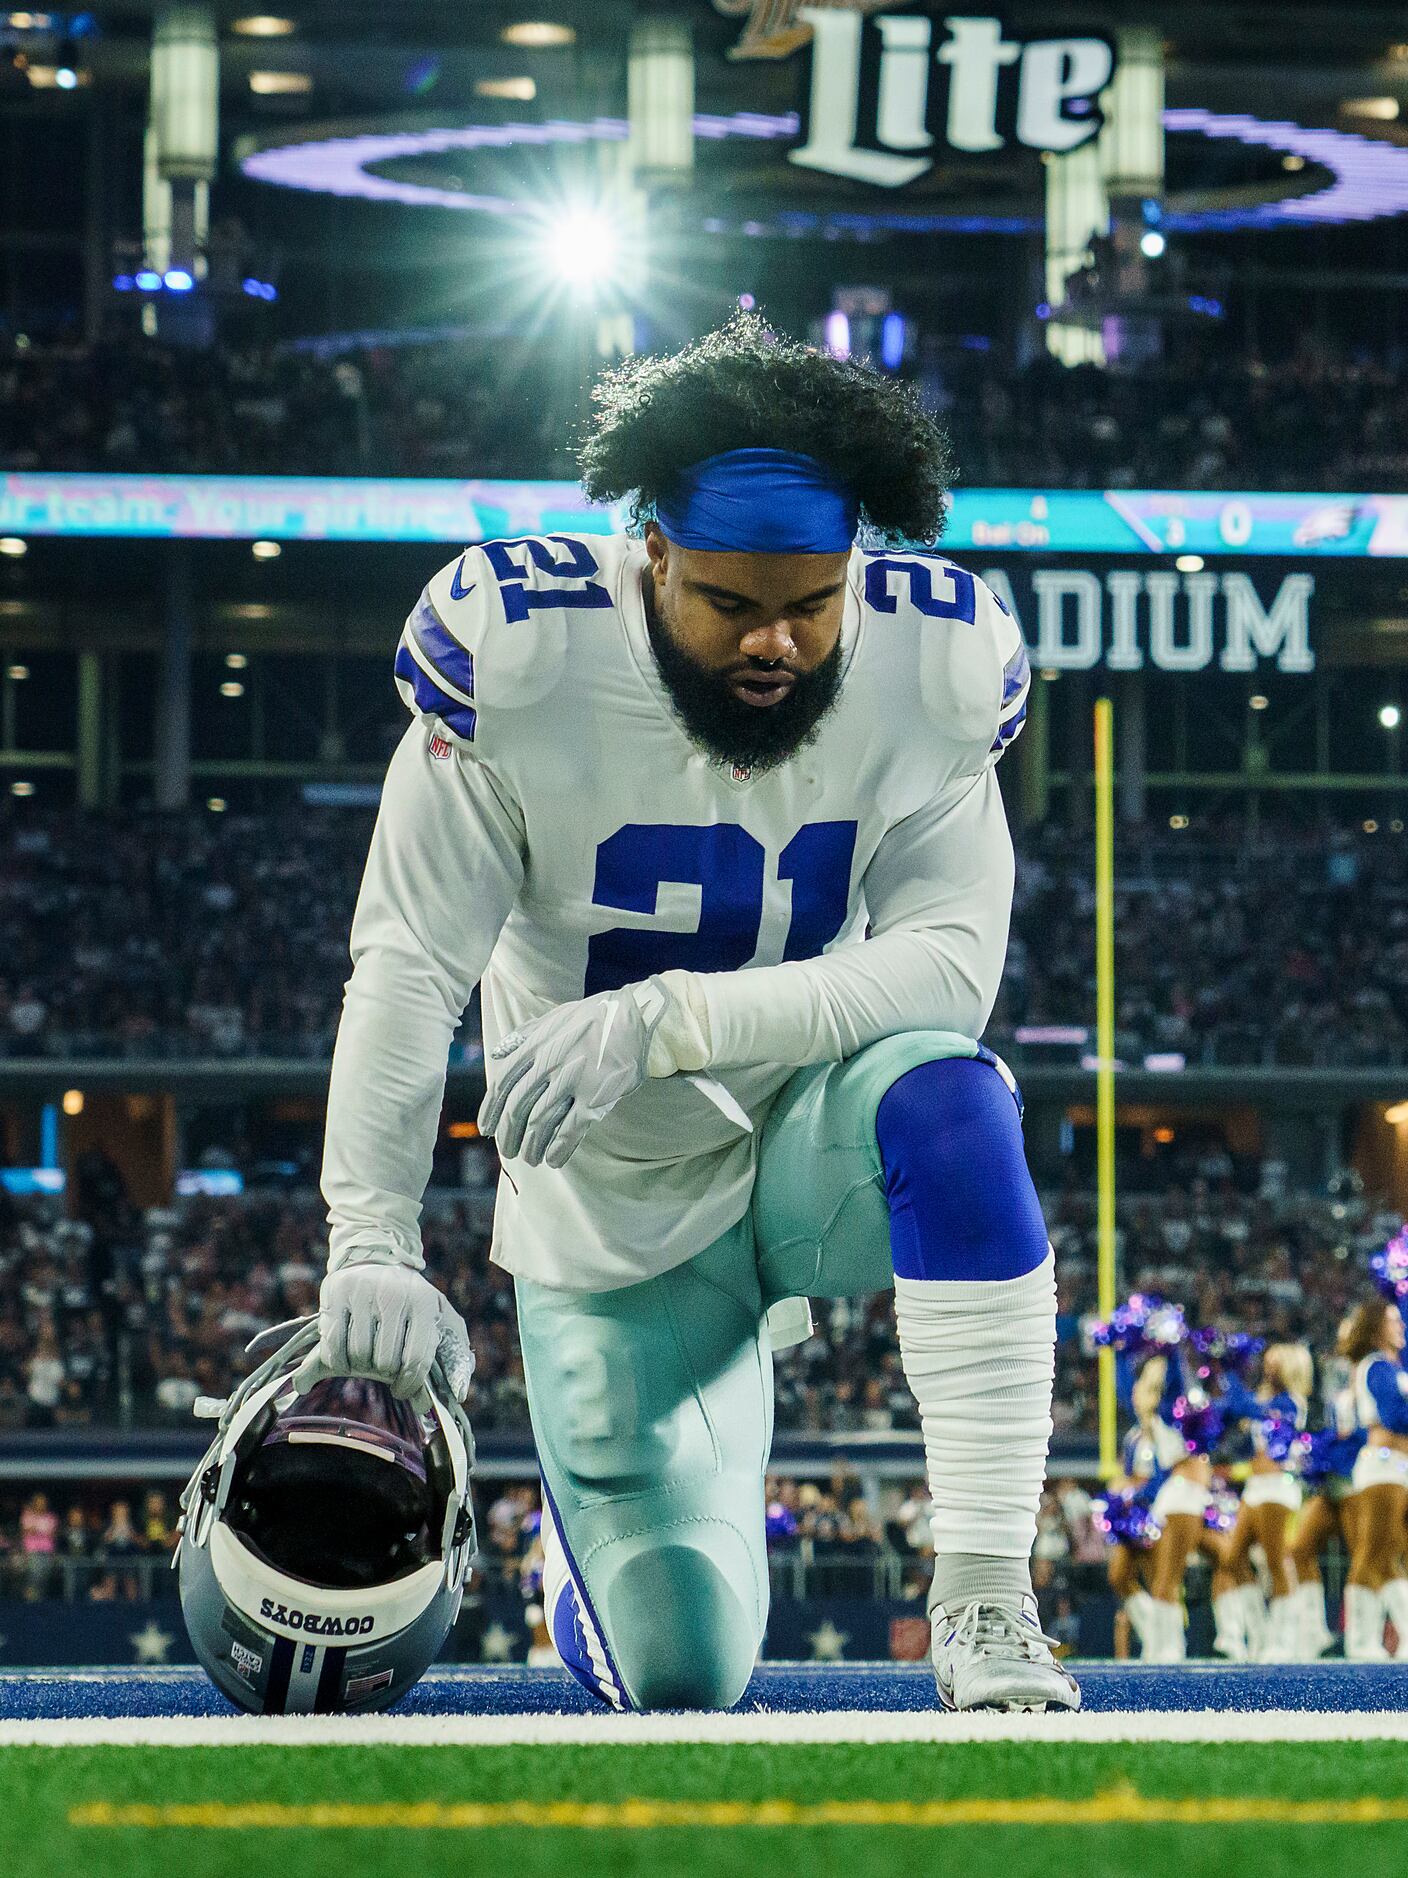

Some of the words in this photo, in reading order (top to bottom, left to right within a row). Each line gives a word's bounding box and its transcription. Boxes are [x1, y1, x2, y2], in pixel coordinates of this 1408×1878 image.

[786, 7, 1113, 188] Lite
[480, 536, 614, 624] 21
[863, 550, 976, 626] 2
[430, 735, 450, 758] NFL
[584, 820, 858, 998] 21
[260, 1598, 375, 1636] COWBOYS
